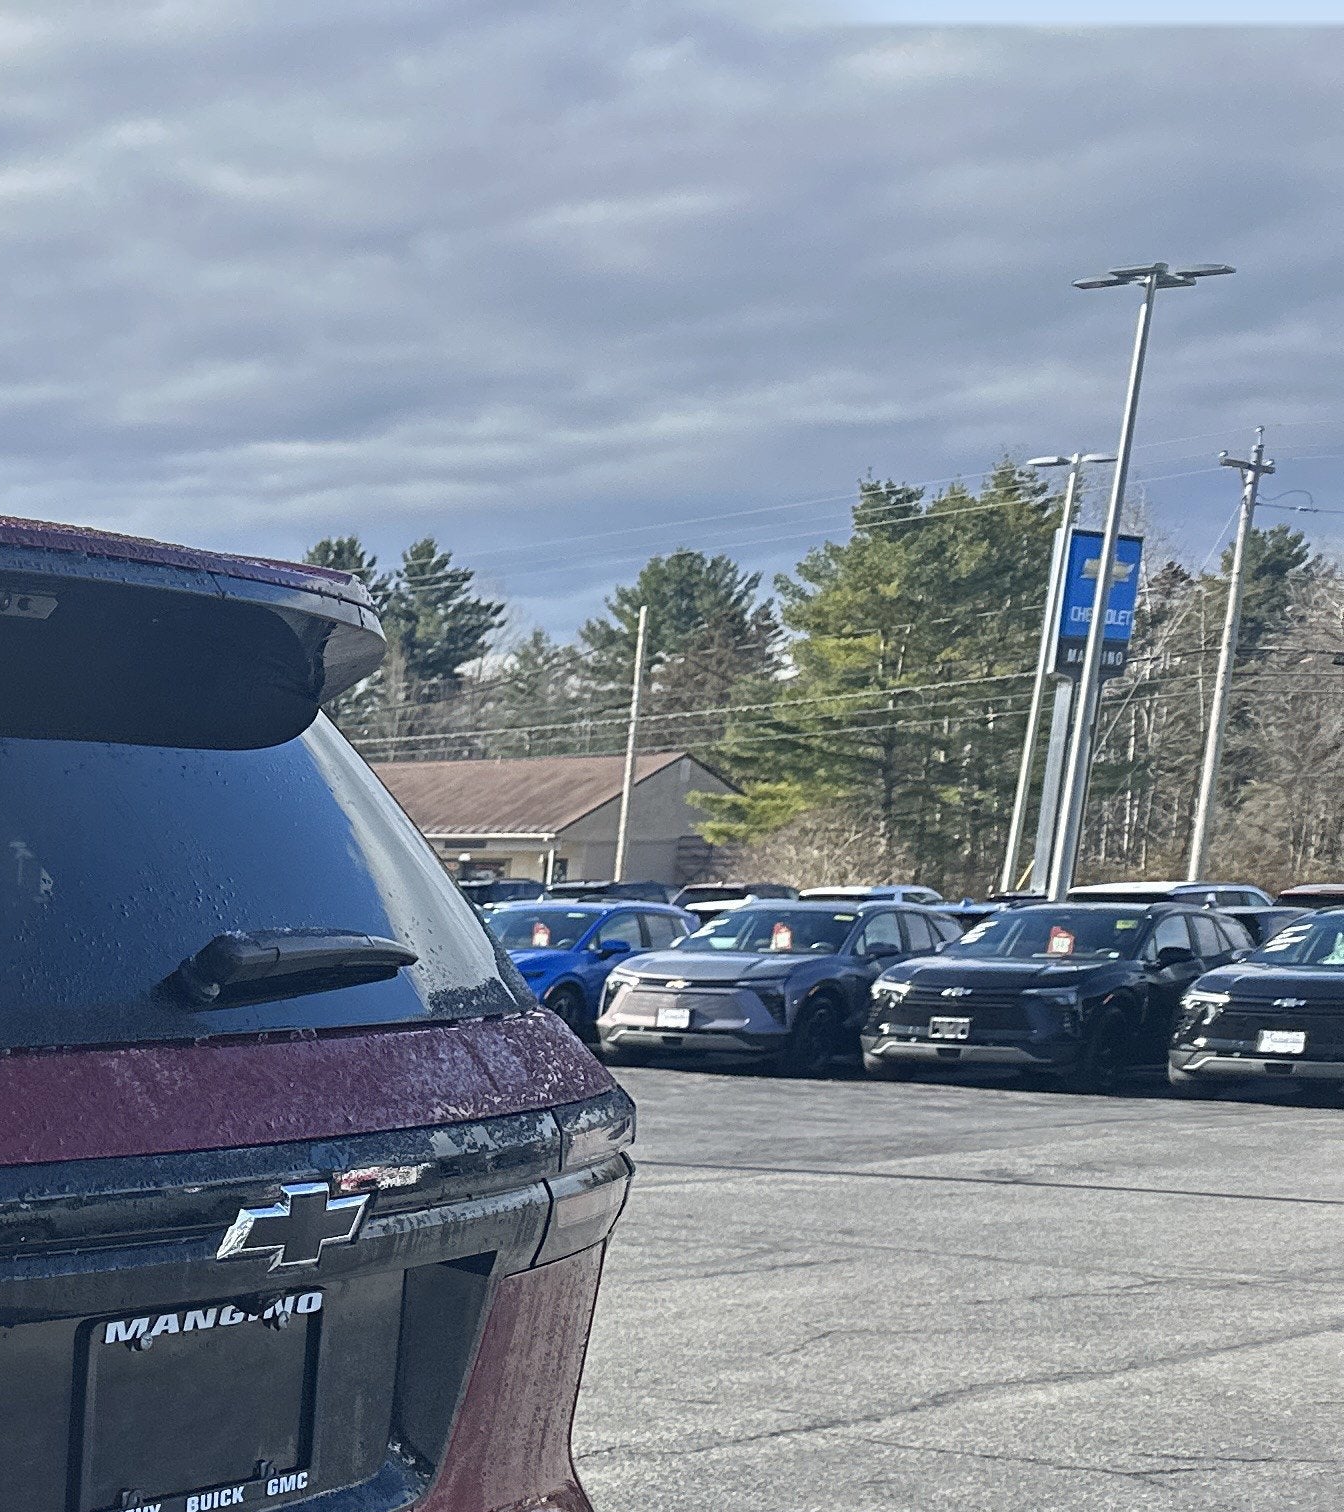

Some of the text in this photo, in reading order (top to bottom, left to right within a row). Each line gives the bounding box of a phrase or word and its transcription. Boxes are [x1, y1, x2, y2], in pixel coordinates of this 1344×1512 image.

[1070, 606, 1132, 625] CHEOLET
[1067, 648, 1123, 666] MAINO
[104, 1291, 323, 1344] MANGNO
[266, 1471, 309, 1497] GMC
